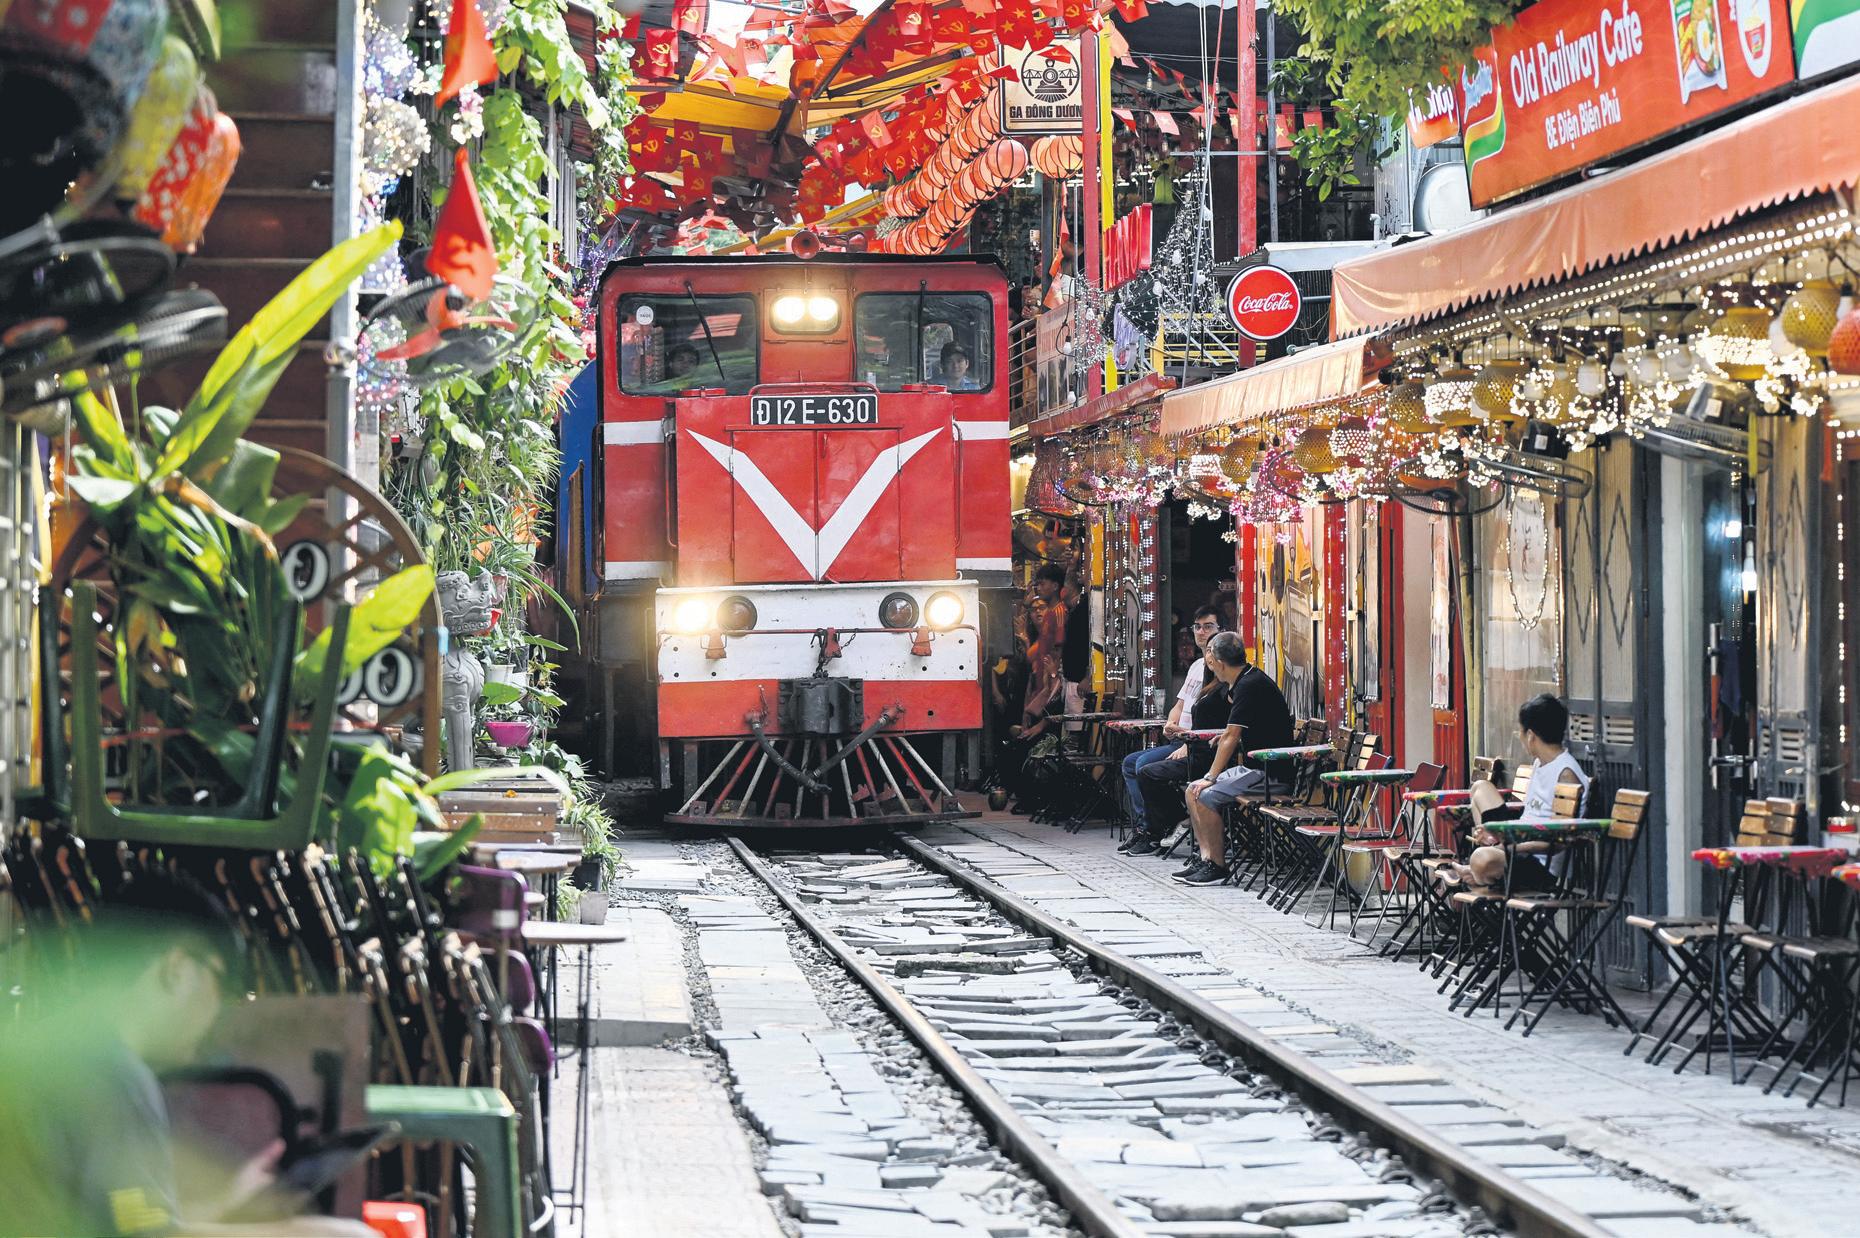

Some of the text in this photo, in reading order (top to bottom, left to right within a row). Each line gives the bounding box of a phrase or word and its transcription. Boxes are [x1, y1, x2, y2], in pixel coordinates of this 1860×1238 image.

[1510, 47, 1539, 108] Old
[1537, 29, 1599, 88] Railway
[1601, 0, 1642, 67] Cafe
[1010, 103, 1082, 118] GA ĐÔNG DƯƠN
[1557, 108, 1580, 150] Điện
[1578, 99, 1602, 136] Biên
[1238, 292, 1292, 314] Coca-Cola
